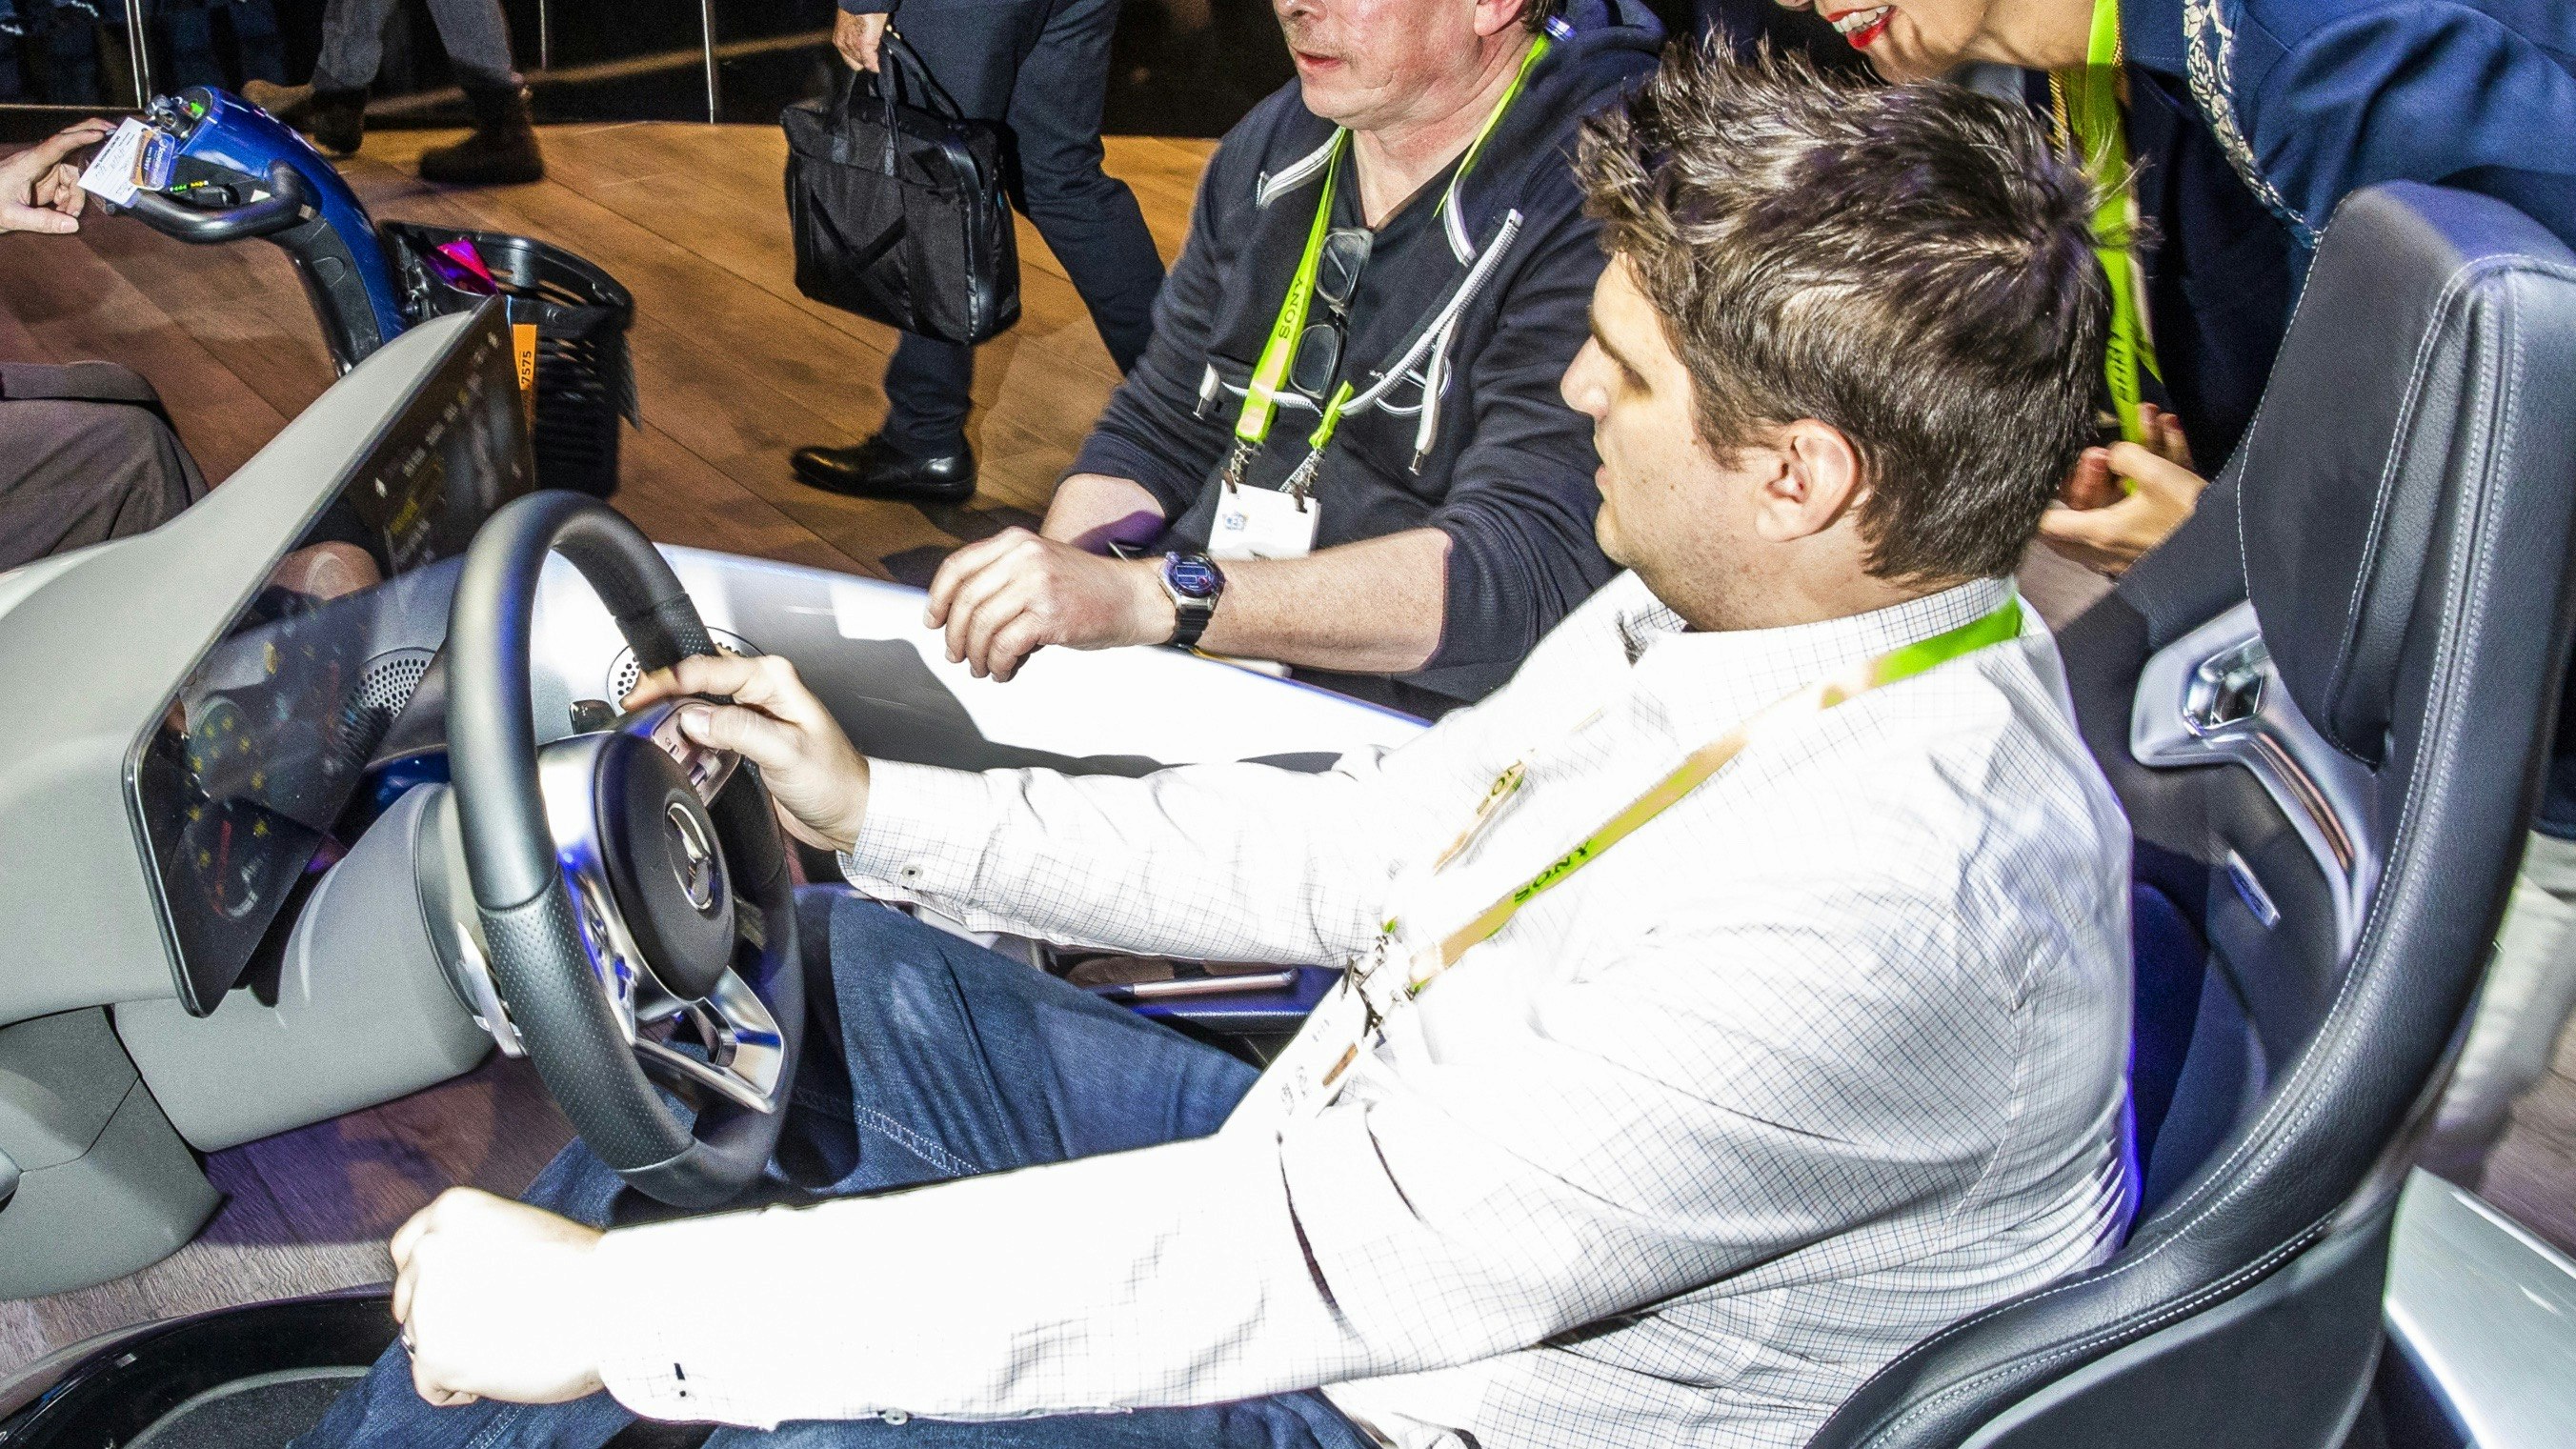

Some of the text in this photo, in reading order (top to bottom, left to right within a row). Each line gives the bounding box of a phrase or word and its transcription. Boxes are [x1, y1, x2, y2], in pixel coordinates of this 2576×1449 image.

[1278, 277, 1303, 339] SONY
[521, 351, 533, 384] 7575
[1515, 841, 1592, 902] SONY
